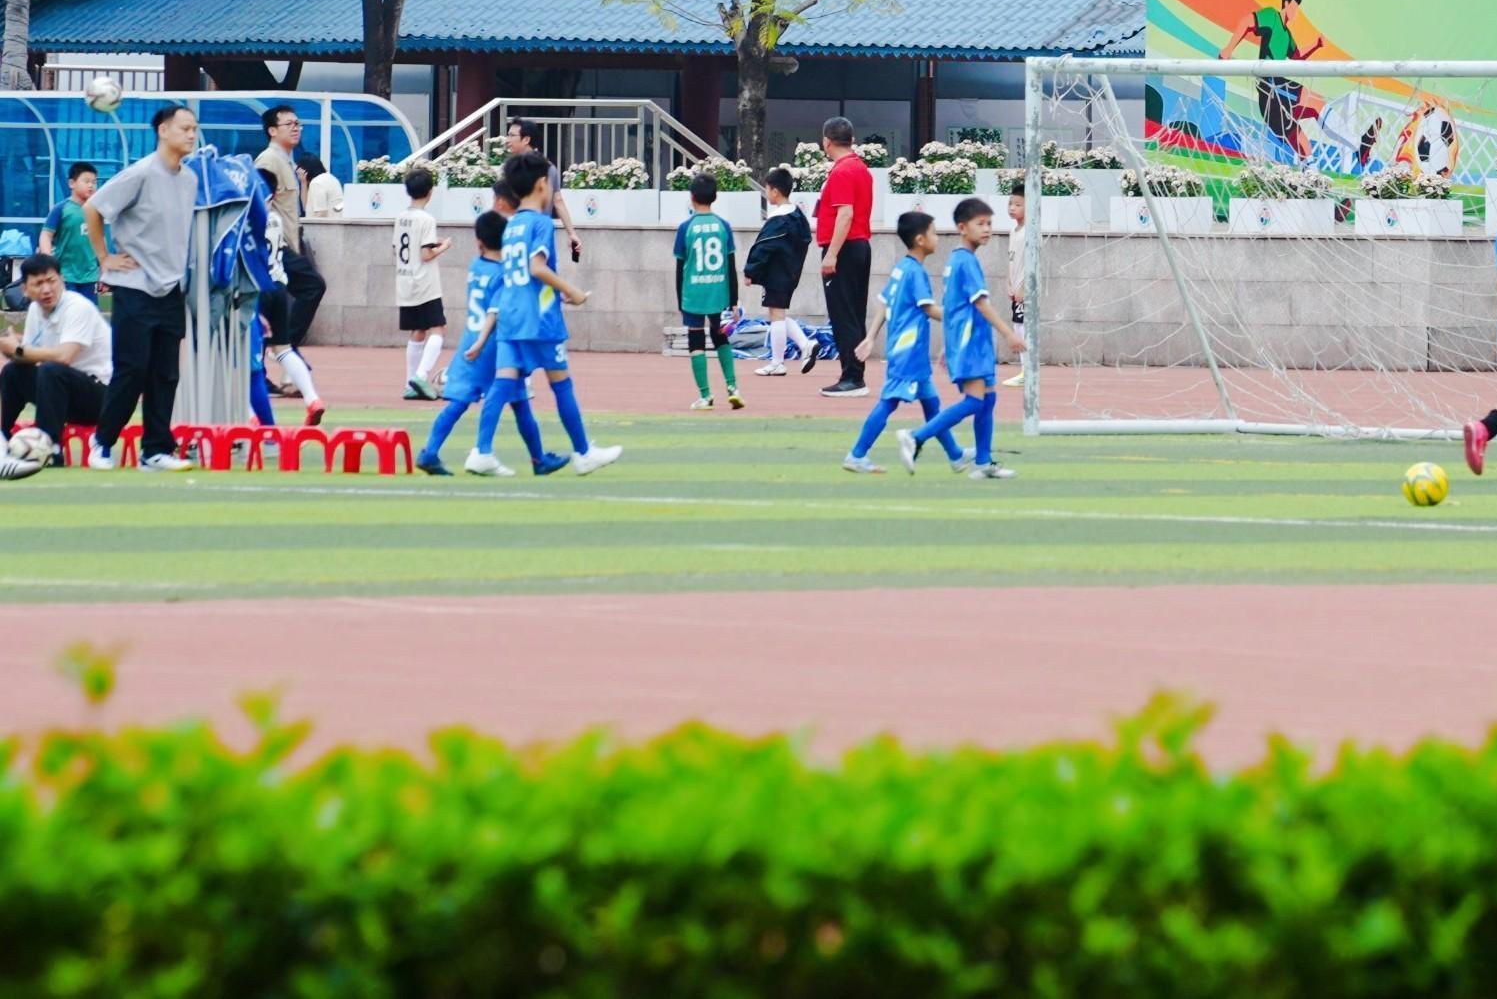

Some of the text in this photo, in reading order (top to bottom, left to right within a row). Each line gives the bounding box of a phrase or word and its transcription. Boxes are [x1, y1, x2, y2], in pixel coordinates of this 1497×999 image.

[399, 232, 410, 264] 8
[693, 236, 724, 272] 18
[467, 288, 487, 332] 5
